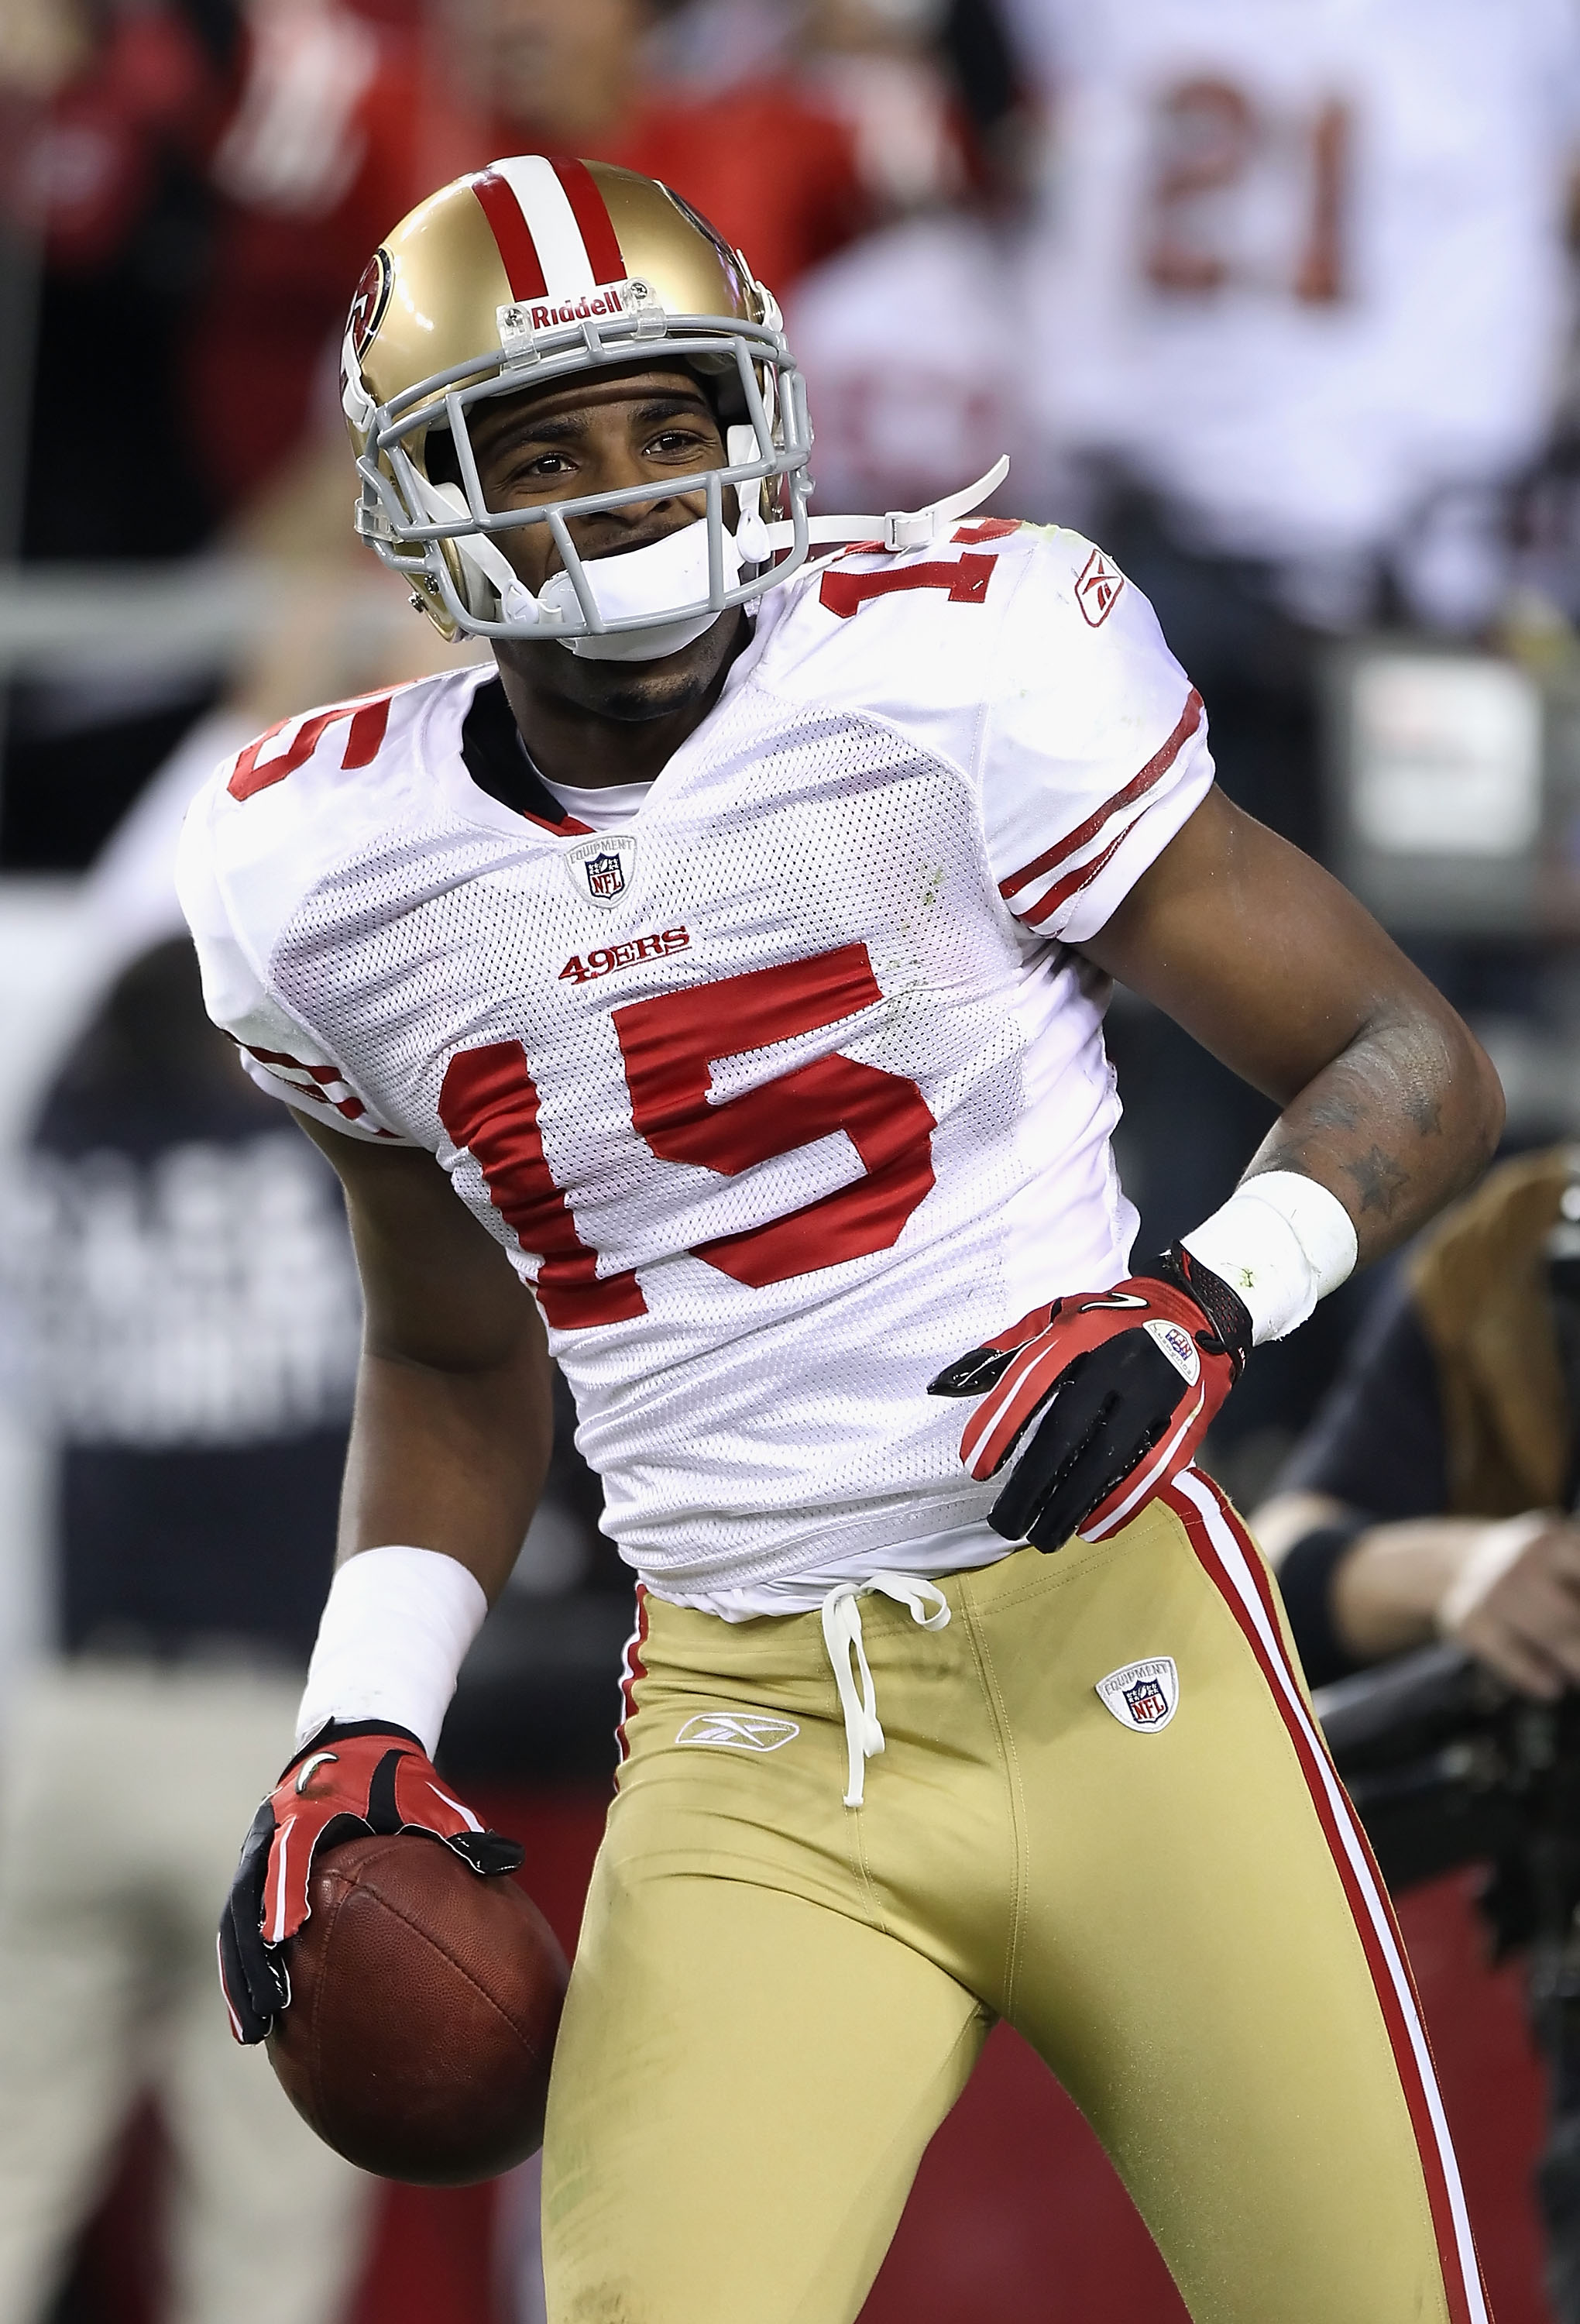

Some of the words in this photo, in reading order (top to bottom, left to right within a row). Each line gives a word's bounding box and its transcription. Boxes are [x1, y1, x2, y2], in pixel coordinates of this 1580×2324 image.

[1146, 76, 1354, 305] 21
[531, 290, 623, 330] Riddell
[569, 838, 633, 865] EQUIPMENT
[592, 871, 622, 895] NFL
[558, 926, 691, 985] 49ERS
[438, 943, 938, 1329] 15
[1173, 1330, 1191, 1353] NFL
[1104, 1662, 1168, 1696] EQUIPMENT
[1132, 1697, 1164, 1720] NFL
